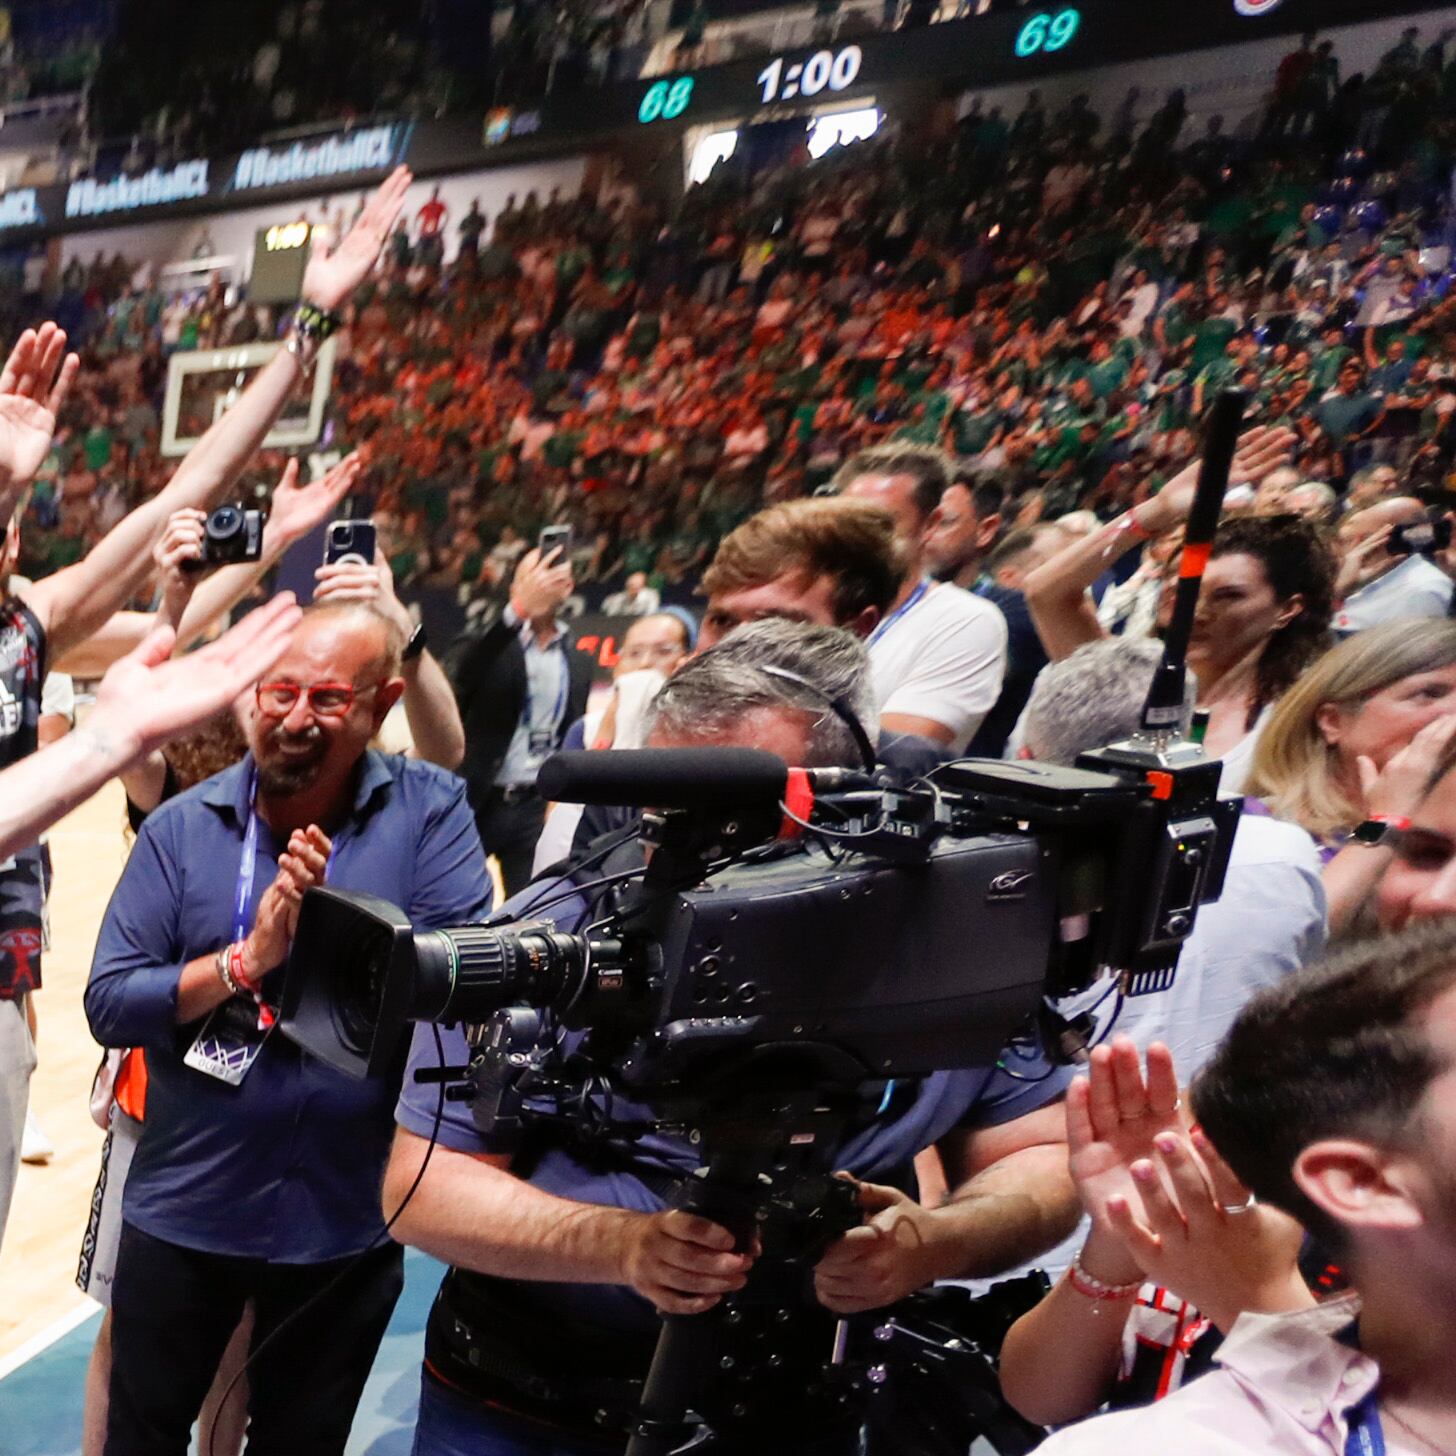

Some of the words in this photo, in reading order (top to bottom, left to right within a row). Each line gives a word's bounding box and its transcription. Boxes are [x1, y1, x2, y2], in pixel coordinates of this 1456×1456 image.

[1014, 7, 1080, 59] 69
[637, 75, 695, 125] 68
[756, 44, 864, 106] 1:00
